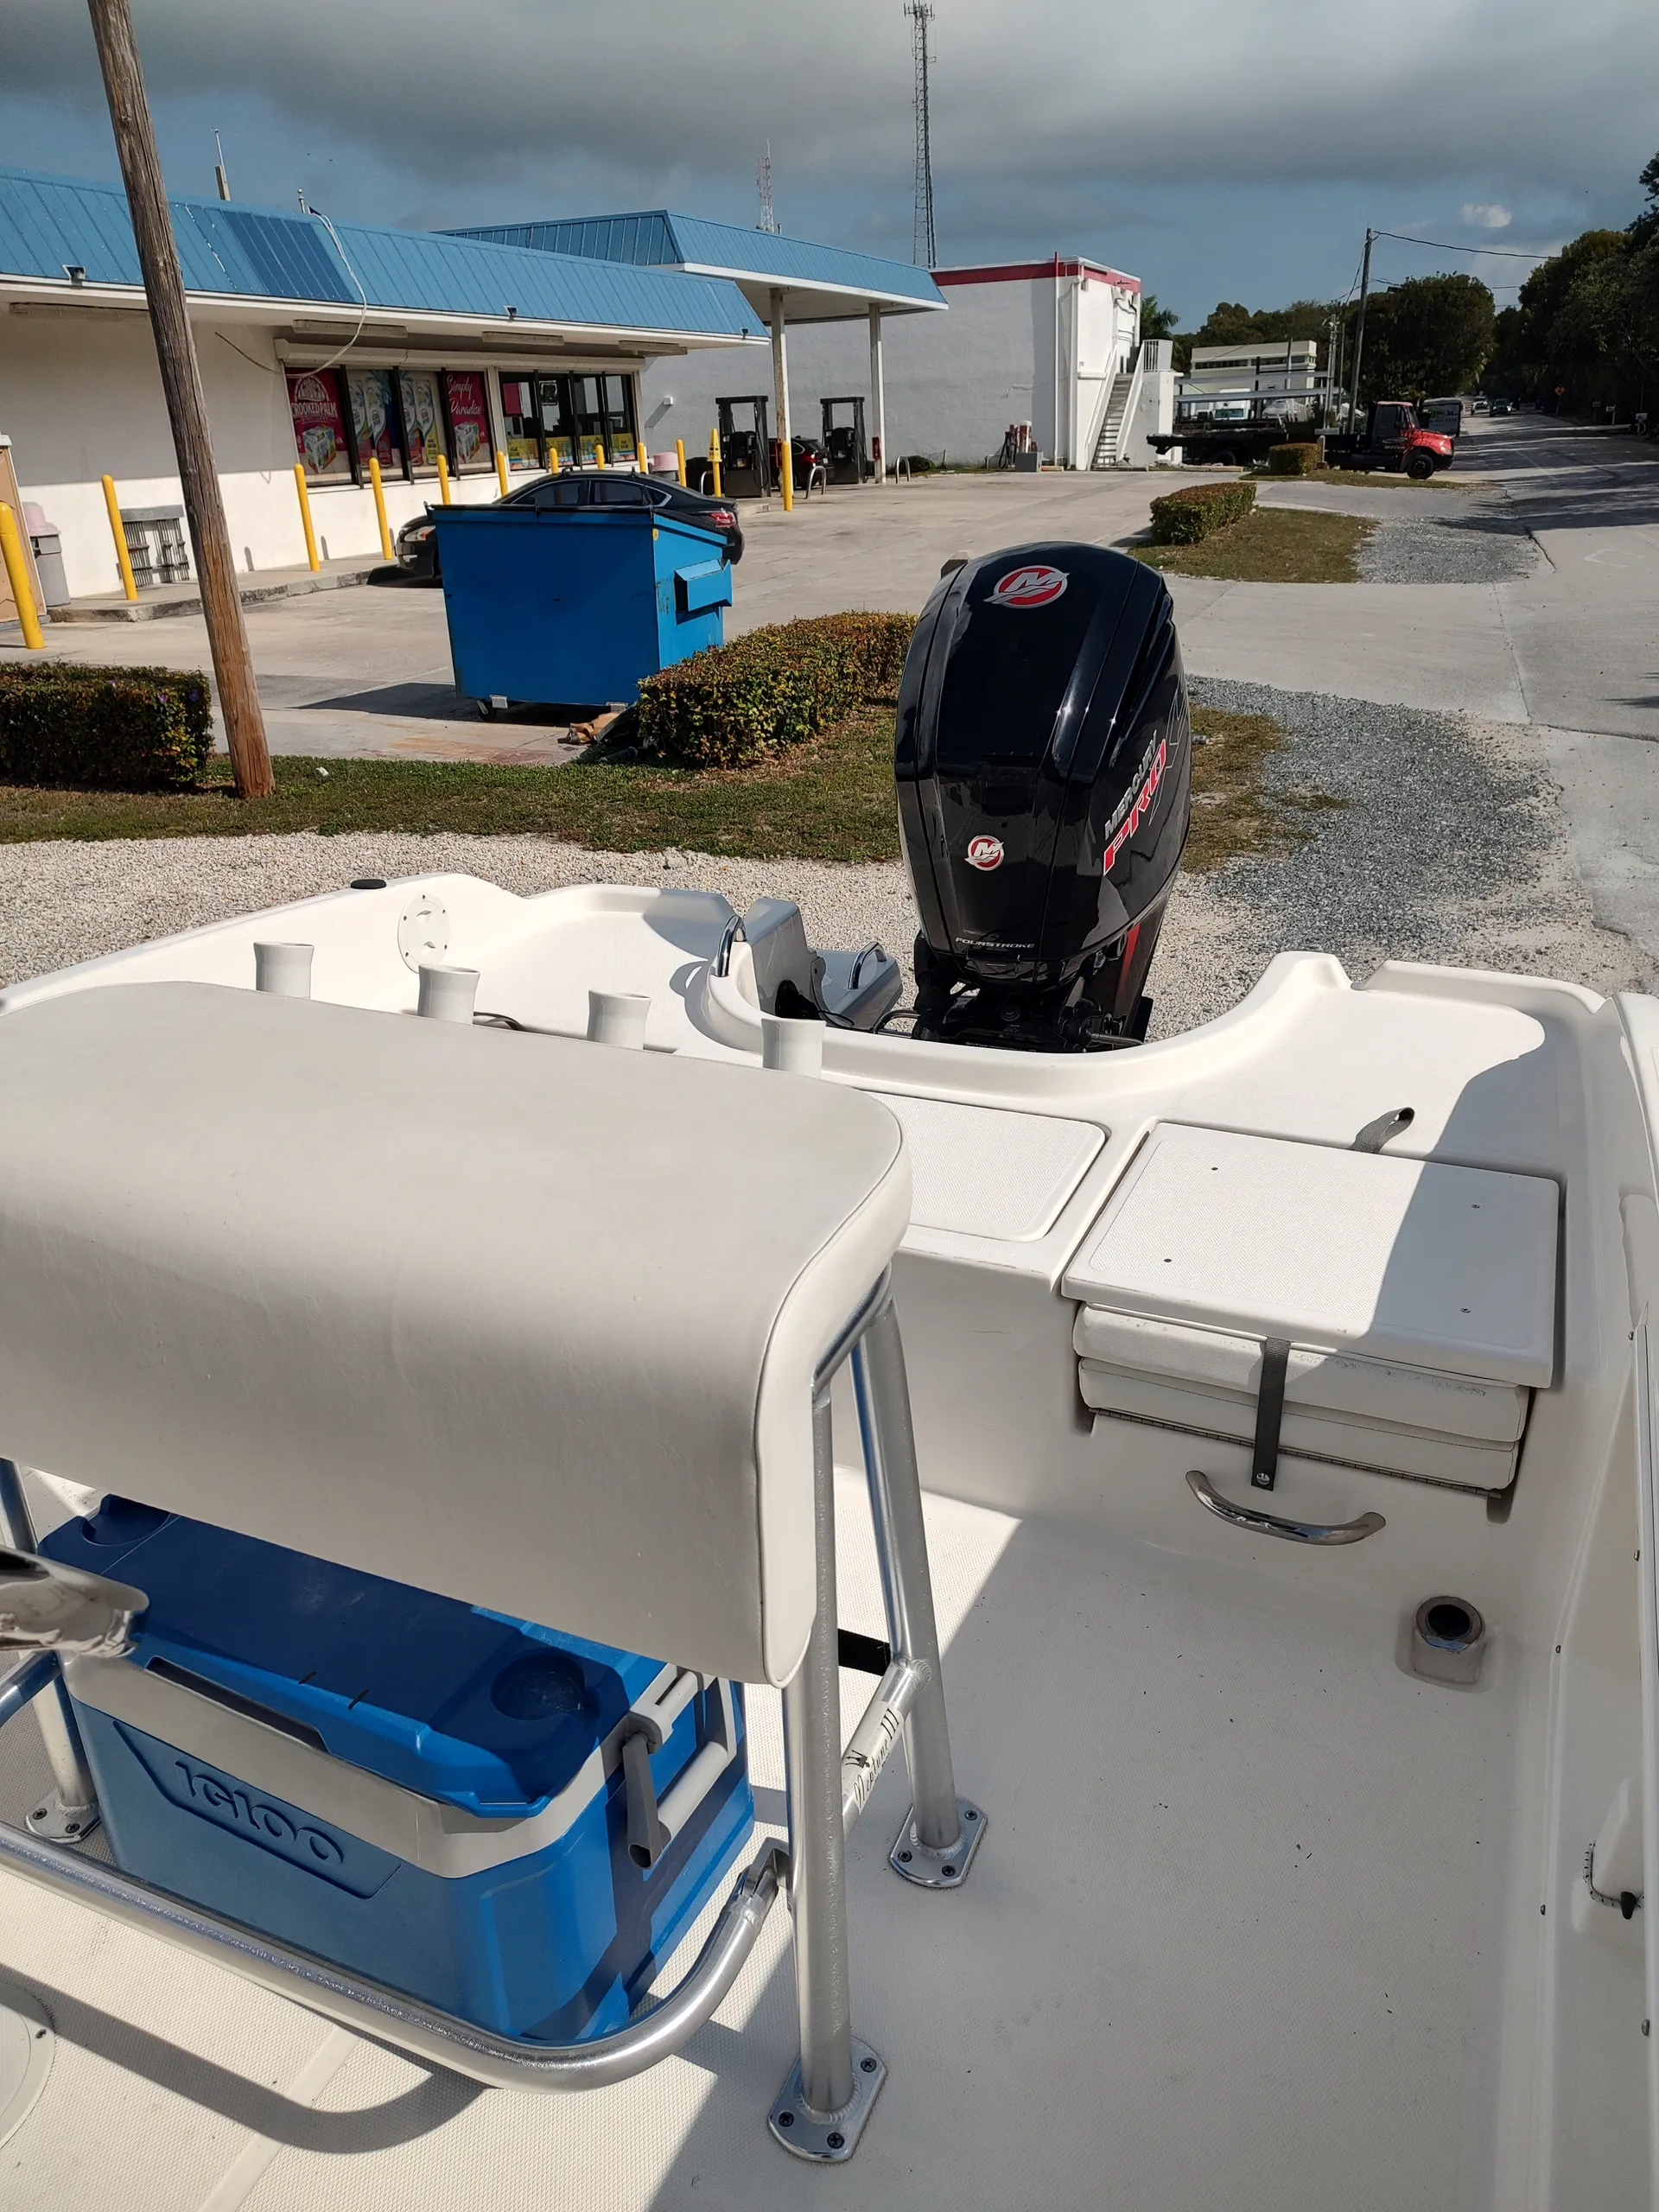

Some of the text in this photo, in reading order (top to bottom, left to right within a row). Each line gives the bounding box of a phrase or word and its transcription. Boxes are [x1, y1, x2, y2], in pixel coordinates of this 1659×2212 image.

[447, 374, 474, 400] Simply
[290, 402, 320, 418] CROOKED
[319, 402, 339, 419] PALM
[449, 397, 481, 416] Paradise
[1104, 729, 1157, 841] MERCURY
[1103, 738, 1166, 877] PRO
[955, 937, 1035, 949] FOURSTROKE
[854, 1738, 888, 1809] Neptune
